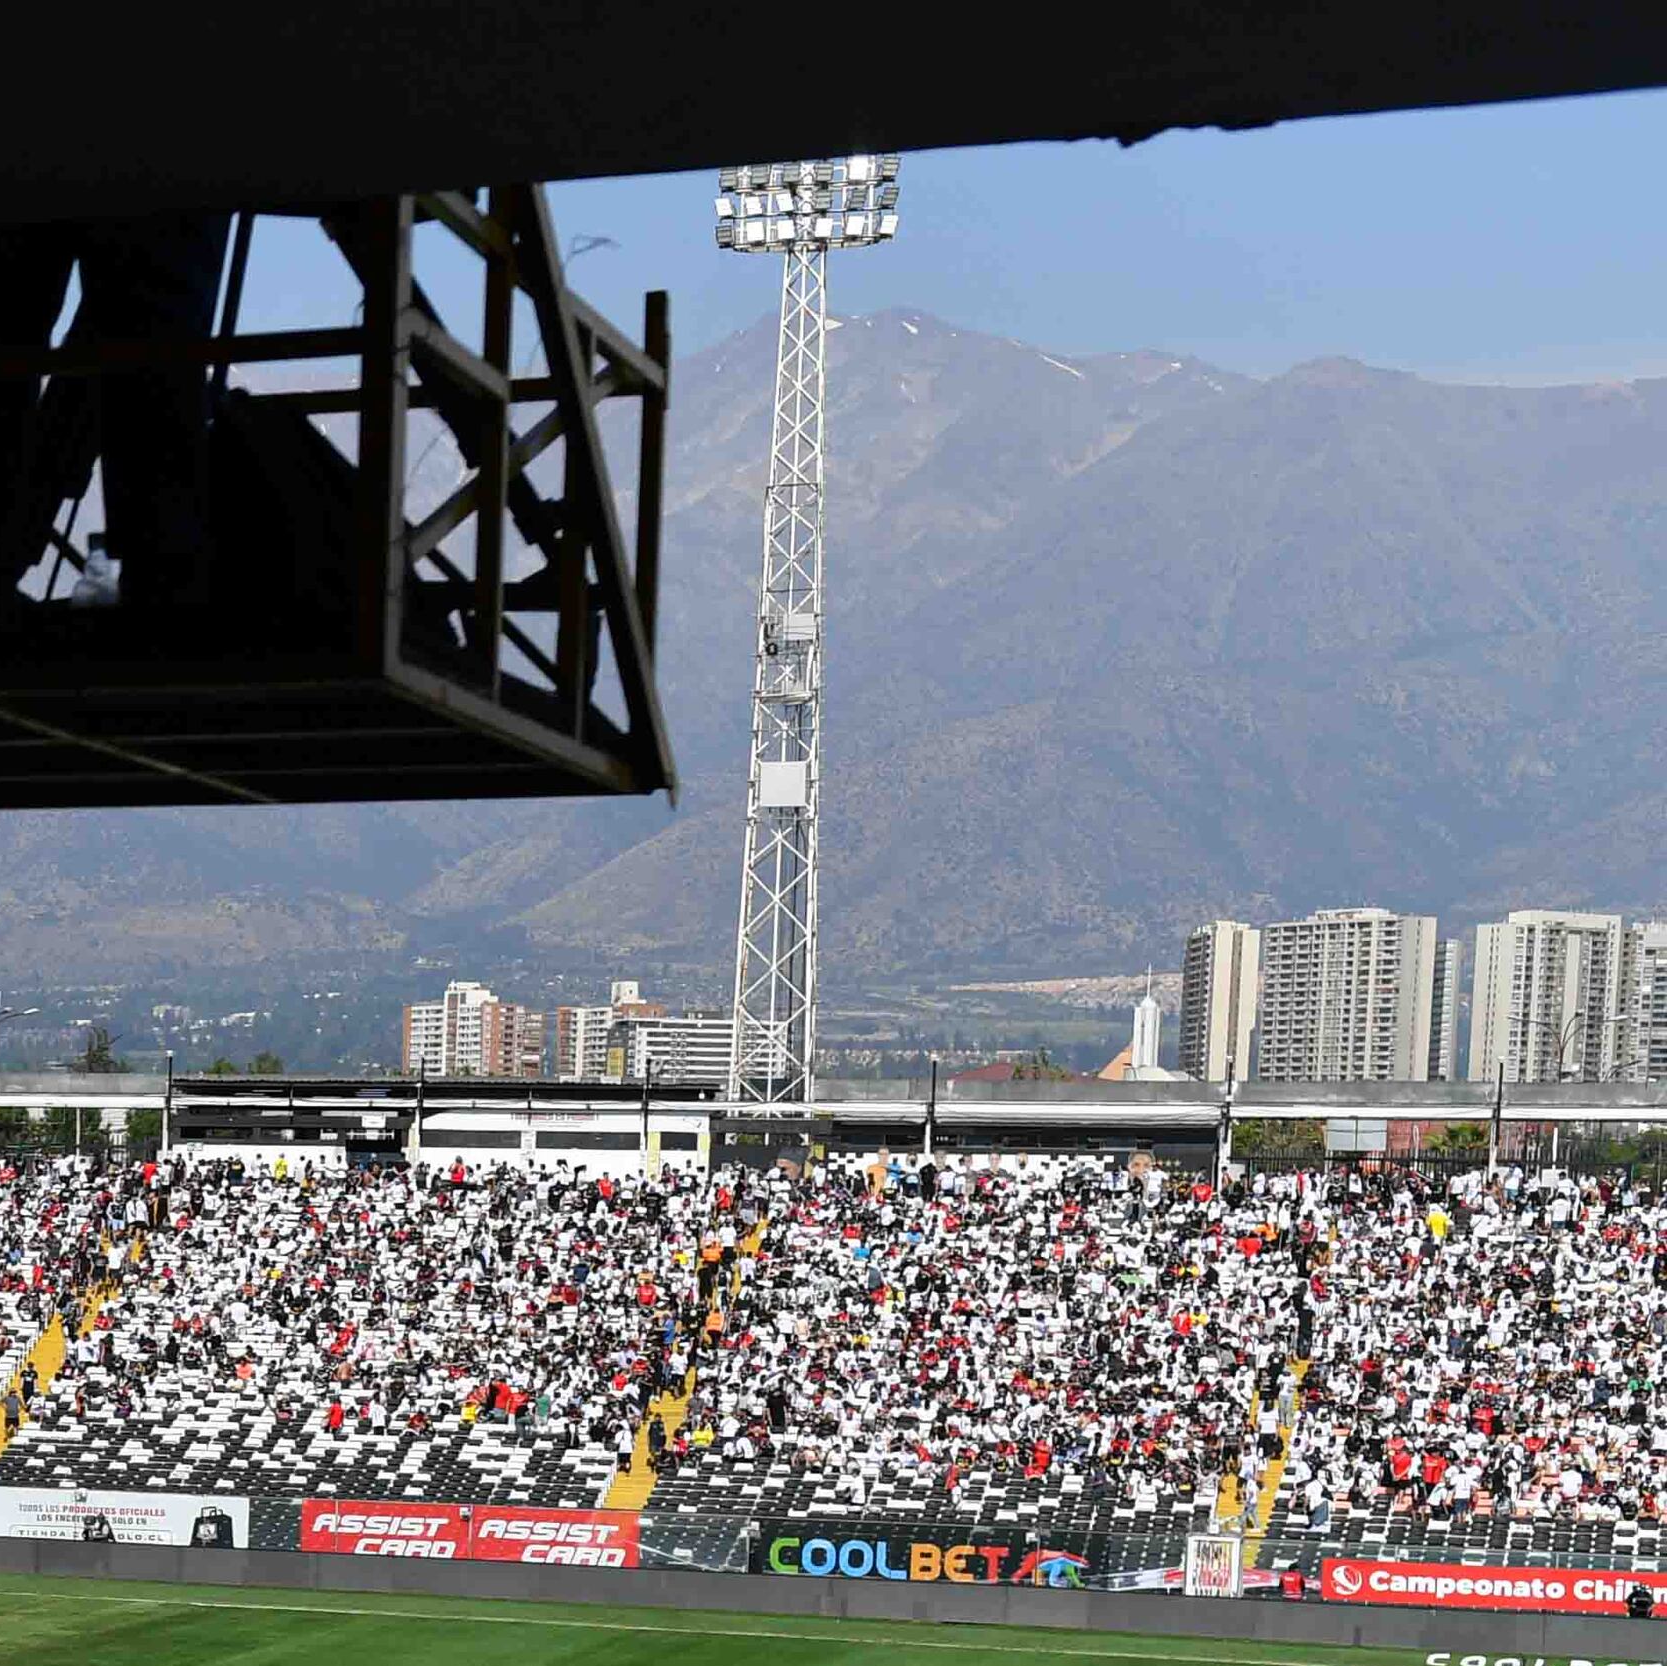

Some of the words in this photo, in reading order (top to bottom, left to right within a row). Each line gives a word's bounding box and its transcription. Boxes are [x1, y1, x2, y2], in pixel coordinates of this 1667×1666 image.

[119, 1507, 166, 1517] OFICIALES
[313, 1513, 450, 1538] ASSIST
[478, 1518, 619, 1544] ASSIST
[354, 1538, 457, 1559] CARD
[521, 1544, 627, 1568] CARD
[769, 1537, 1010, 1585] COOLBET
[1369, 1570, 1565, 1600] Campeonato
[1573, 1578, 1667, 1605] Chiln
